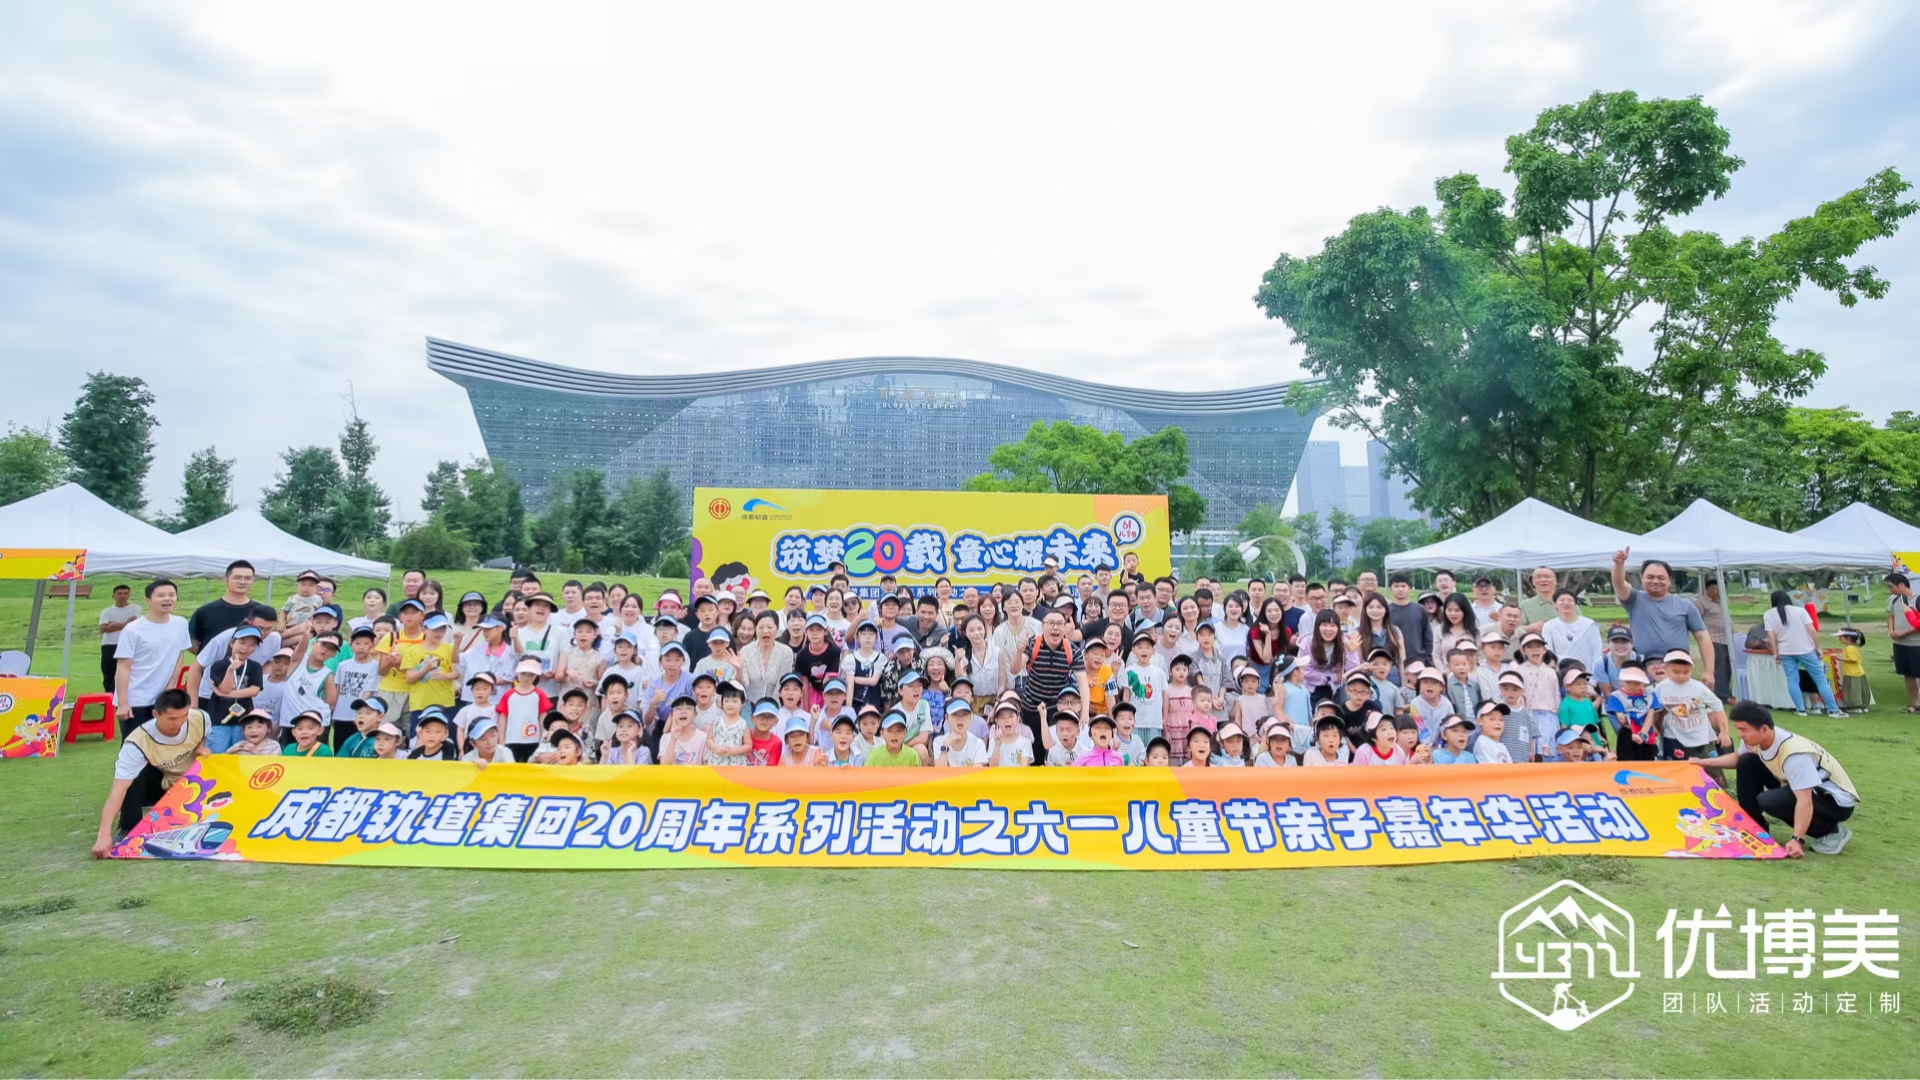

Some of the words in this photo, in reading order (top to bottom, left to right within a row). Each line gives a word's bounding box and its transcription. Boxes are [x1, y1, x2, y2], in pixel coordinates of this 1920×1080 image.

[248, 787, 1649, 856] 成都轨道集团20周年系列活动之六一儿童节亲子嘉年华活动
